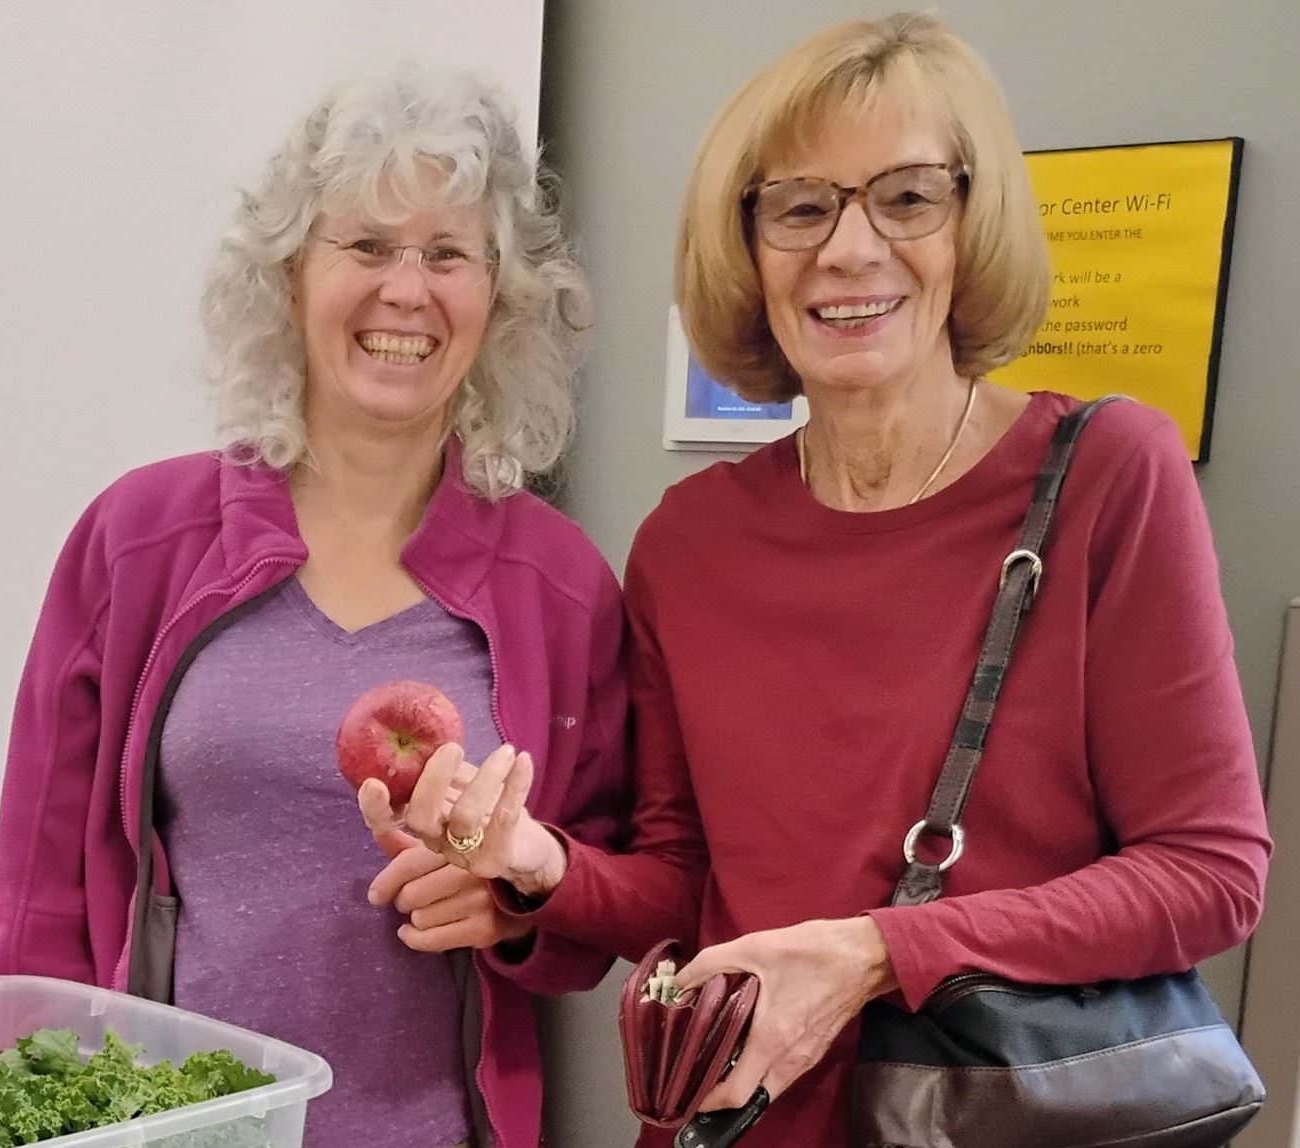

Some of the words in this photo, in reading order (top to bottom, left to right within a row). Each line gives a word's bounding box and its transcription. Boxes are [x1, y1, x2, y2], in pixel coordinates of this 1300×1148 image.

[1062, 198, 1119, 216] Center
[1126, 193, 1171, 212] Wi-Fi
[1045, 231, 1065, 242] IME
[1068, 231, 1087, 241] YOU
[1091, 229, 1120, 241] ENTER
[1125, 228, 1142, 239] THE
[1069, 271, 1091, 284] will
[1095, 271, 1110, 284] be
[1114, 273, 1121, 283] a
[1042, 319, 1061, 332] he
[1065, 317, 1127, 334] password
[1122, 345, 1129, 354] a
[1133, 343, 1162, 354] zero
